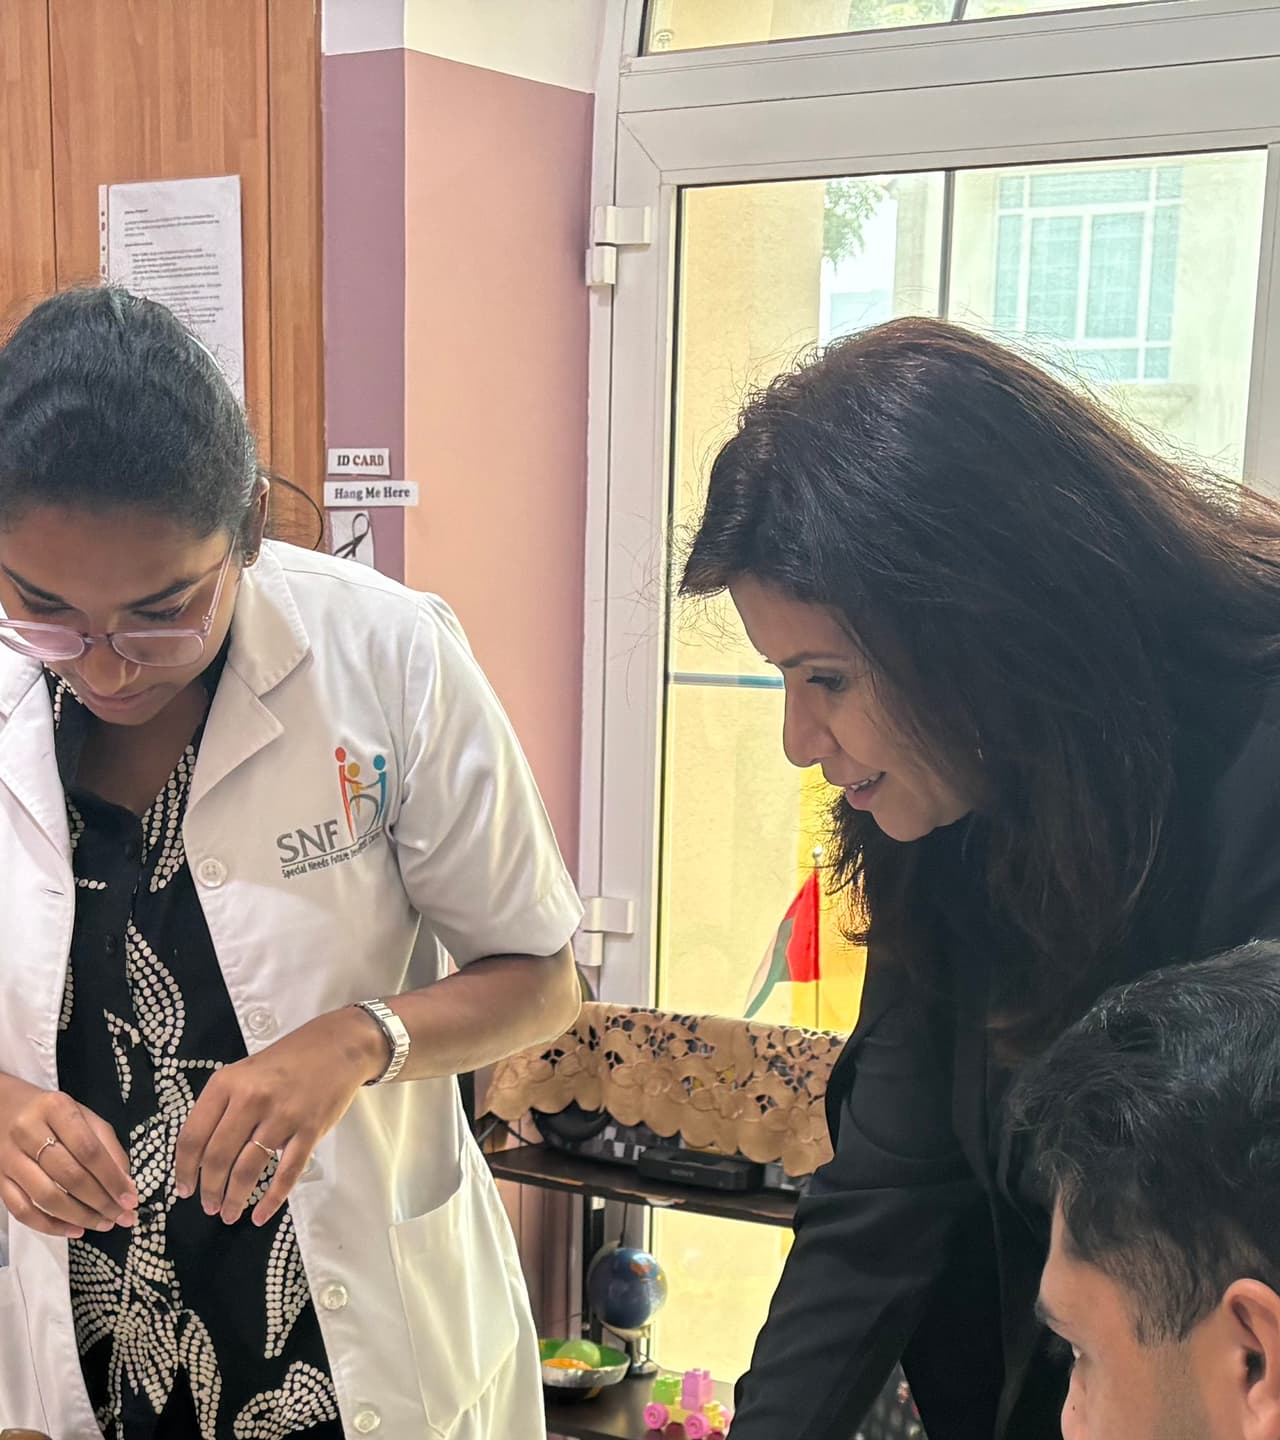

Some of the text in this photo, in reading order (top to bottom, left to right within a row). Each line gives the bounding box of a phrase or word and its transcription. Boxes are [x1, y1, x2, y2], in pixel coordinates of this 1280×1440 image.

[337, 455, 384, 466] ID CARD
[334, 486, 410, 501] Hang Me Here
[276, 819, 338, 864] SNF
[282, 863, 307, 879] Special
[308, 858, 330, 870] Needs
[330, 851, 350, 866] Future
